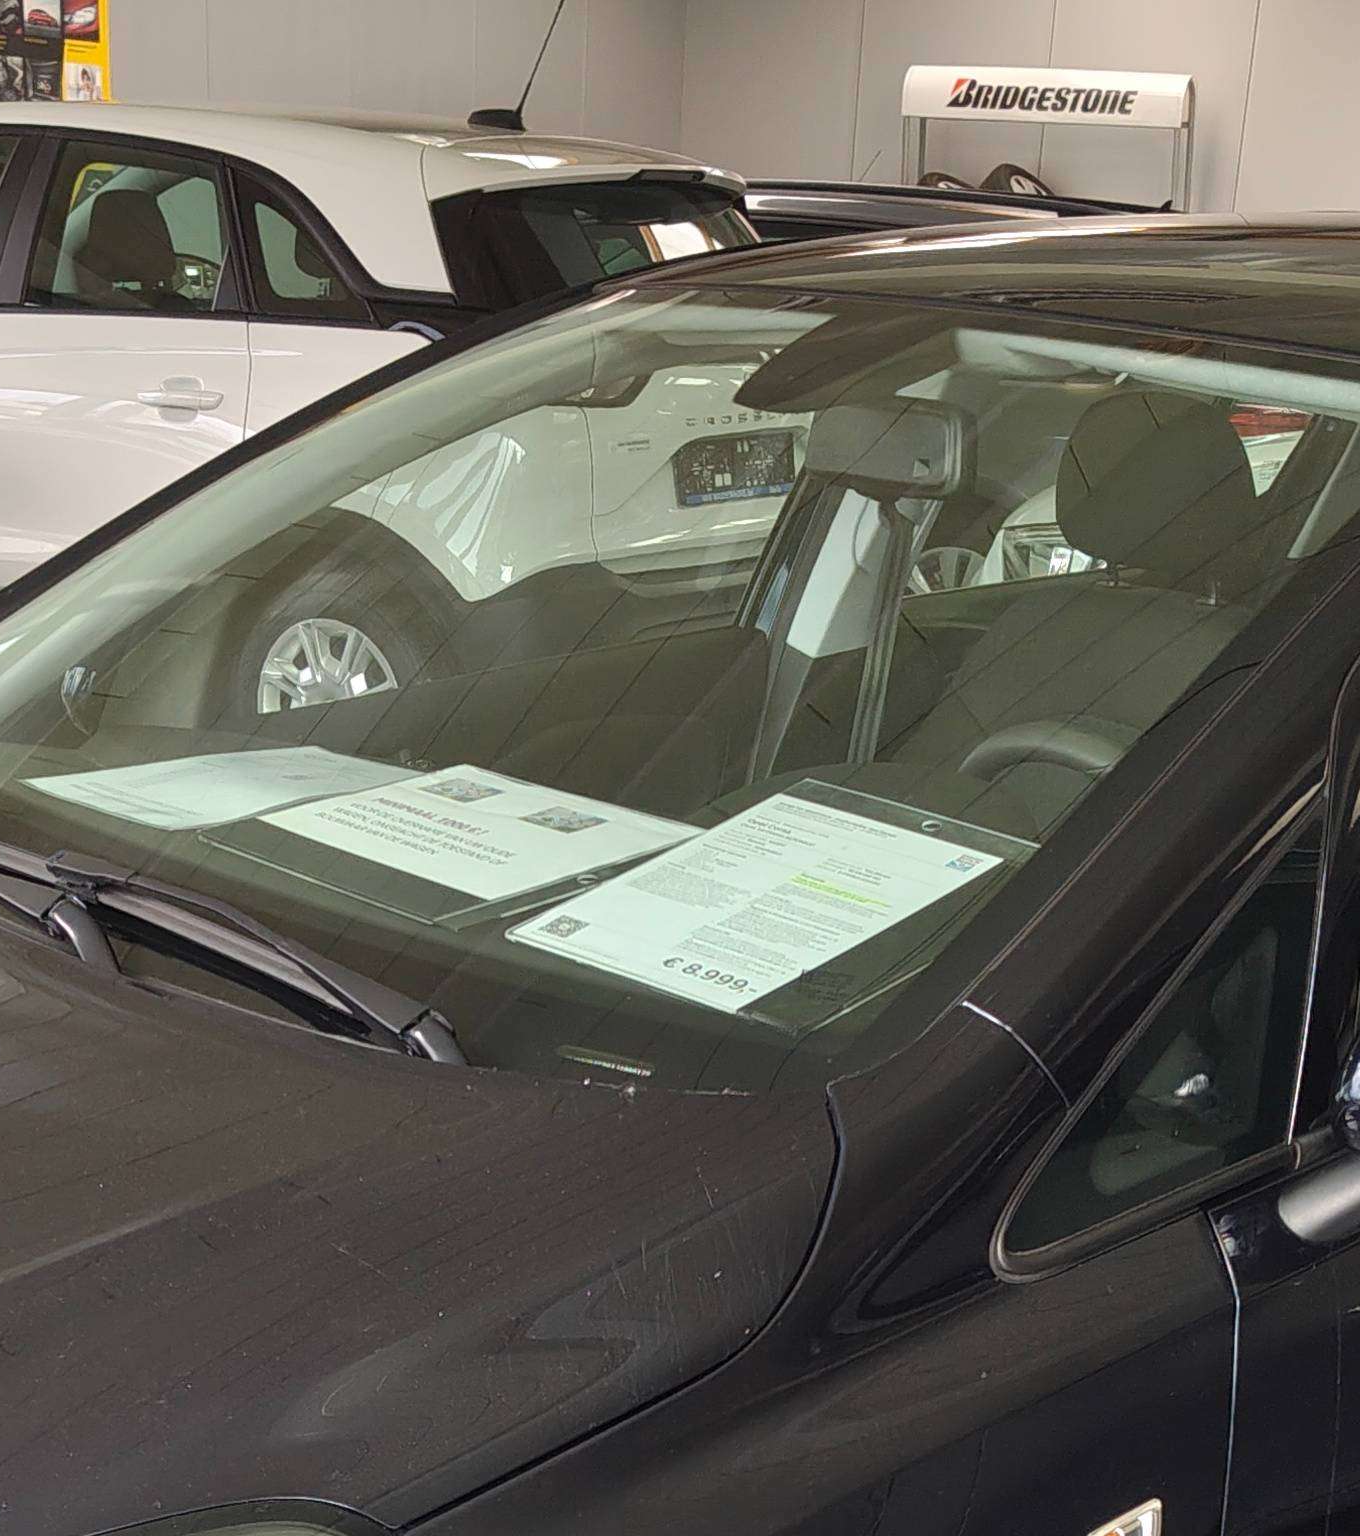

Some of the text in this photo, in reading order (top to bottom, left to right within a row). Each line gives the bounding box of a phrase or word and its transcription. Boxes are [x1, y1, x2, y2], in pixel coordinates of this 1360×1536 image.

[946, 78, 1138, 115] BRIDGESTONE
[662, 956, 758, 994] € 8.999,-
